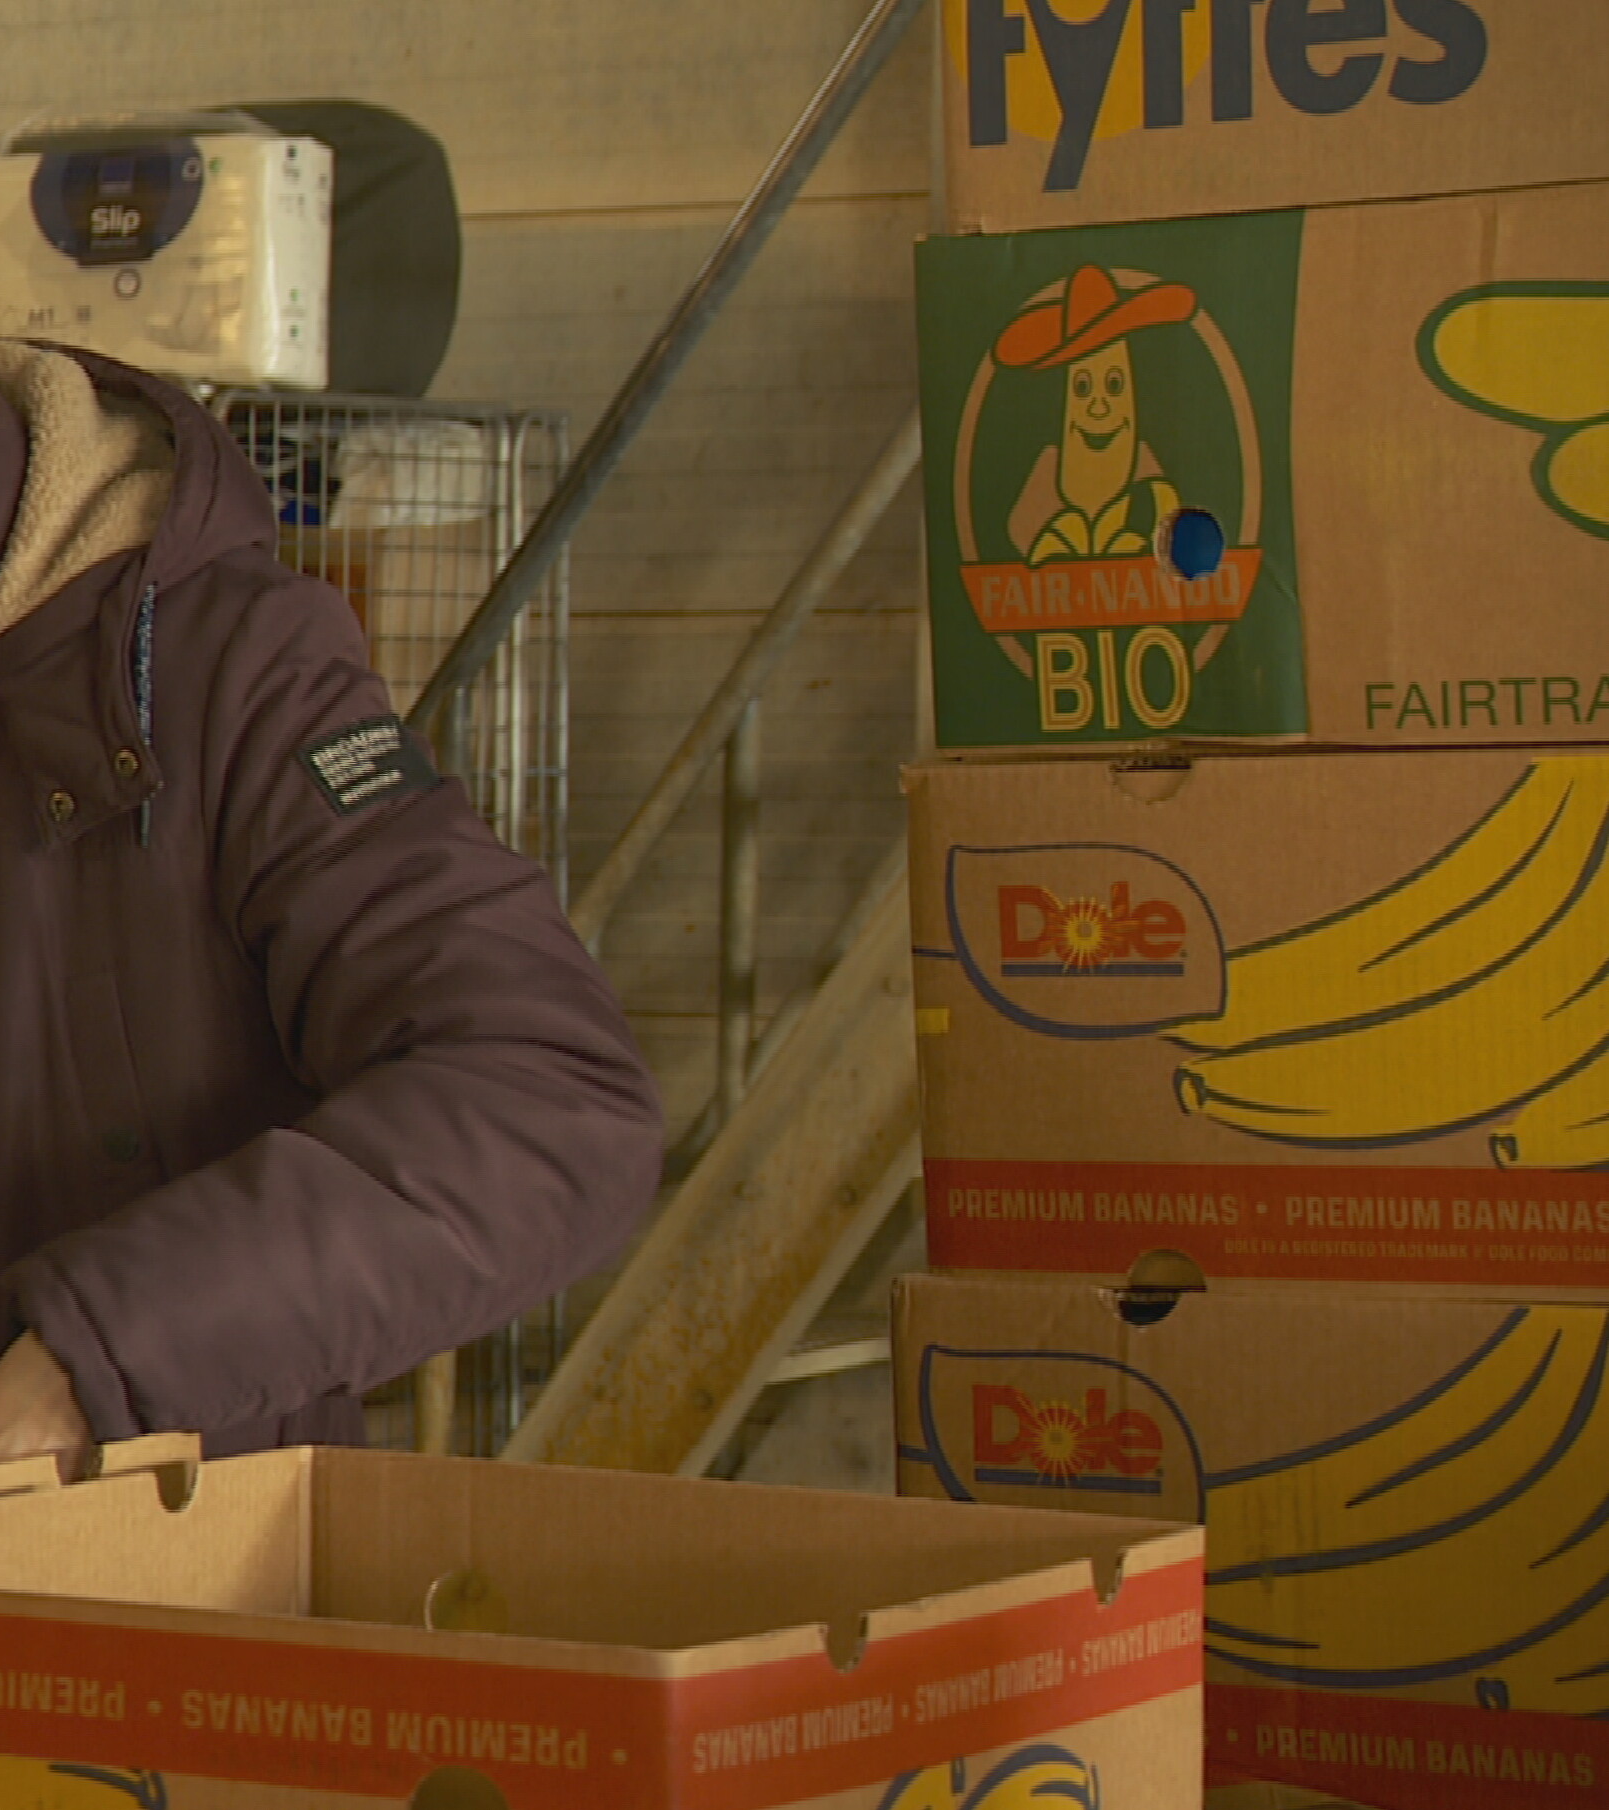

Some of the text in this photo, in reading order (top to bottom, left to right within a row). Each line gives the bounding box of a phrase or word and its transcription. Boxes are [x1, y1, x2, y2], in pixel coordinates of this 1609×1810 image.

[91, 204, 141, 237] Slip
[1035, 626, 1190, 733] BIO
[998, 881, 1186, 968] Dole
[948, 1189, 1609, 1234] PREMIUM BANANAS PREMIUM BANANAS
[1379, 1242, 1468, 1258] TRADEMARK
[972, 1384, 1164, 1480] Dole
[915, 1670, 991, 1720] BANANAS
[992, 1648, 1063, 1701] PREMIUM
[181, 1687, 371, 1745] BANANAS
[387, 1708, 588, 1769] PREMIUM
[692, 1715, 796, 1773] BANANAS
[803, 1694, 893, 1750] PREMIUM
[1257, 1725, 1595, 1784] PREMIUM BANANAS
